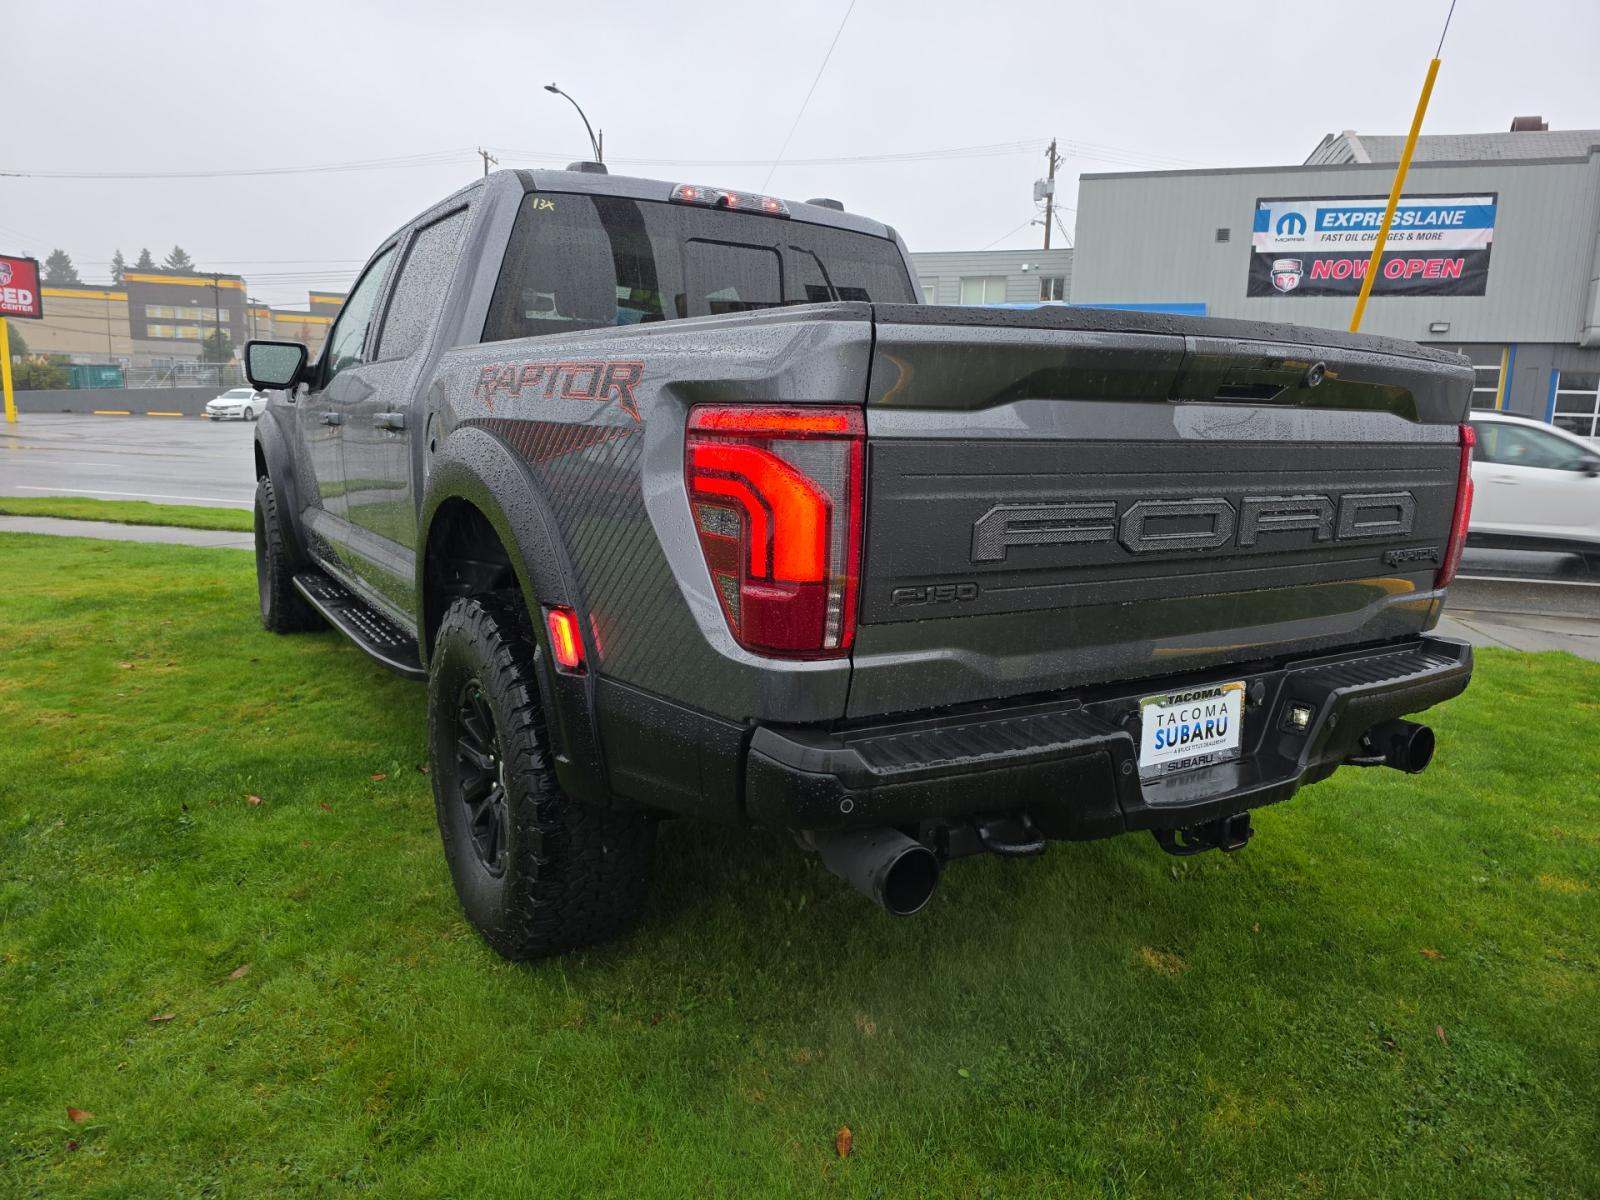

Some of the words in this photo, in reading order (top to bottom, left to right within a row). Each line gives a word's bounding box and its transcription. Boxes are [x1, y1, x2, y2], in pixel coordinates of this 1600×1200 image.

[1322, 210, 1466, 227] EXPRESSLANE
[1320, 233, 1342, 242] FAST
[1345, 233, 1358, 242] OIL
[1361, 232, 1405, 242] CHAGES
[1407, 232, 1414, 241] &
[1416, 231, 1444, 241] MORE
[1384, 258, 1465, 279] OPEN
[1, 303, 33, 312] CENTER
[474, 360, 645, 424] RAPTOR
[970, 490, 1417, 563] FORD
[1167, 687, 1221, 704] TACOMA
[1157, 702, 1228, 726] TACOMA
[1155, 716, 1228, 750] SUBARU
[1168, 754, 1213, 771] SUBARU
